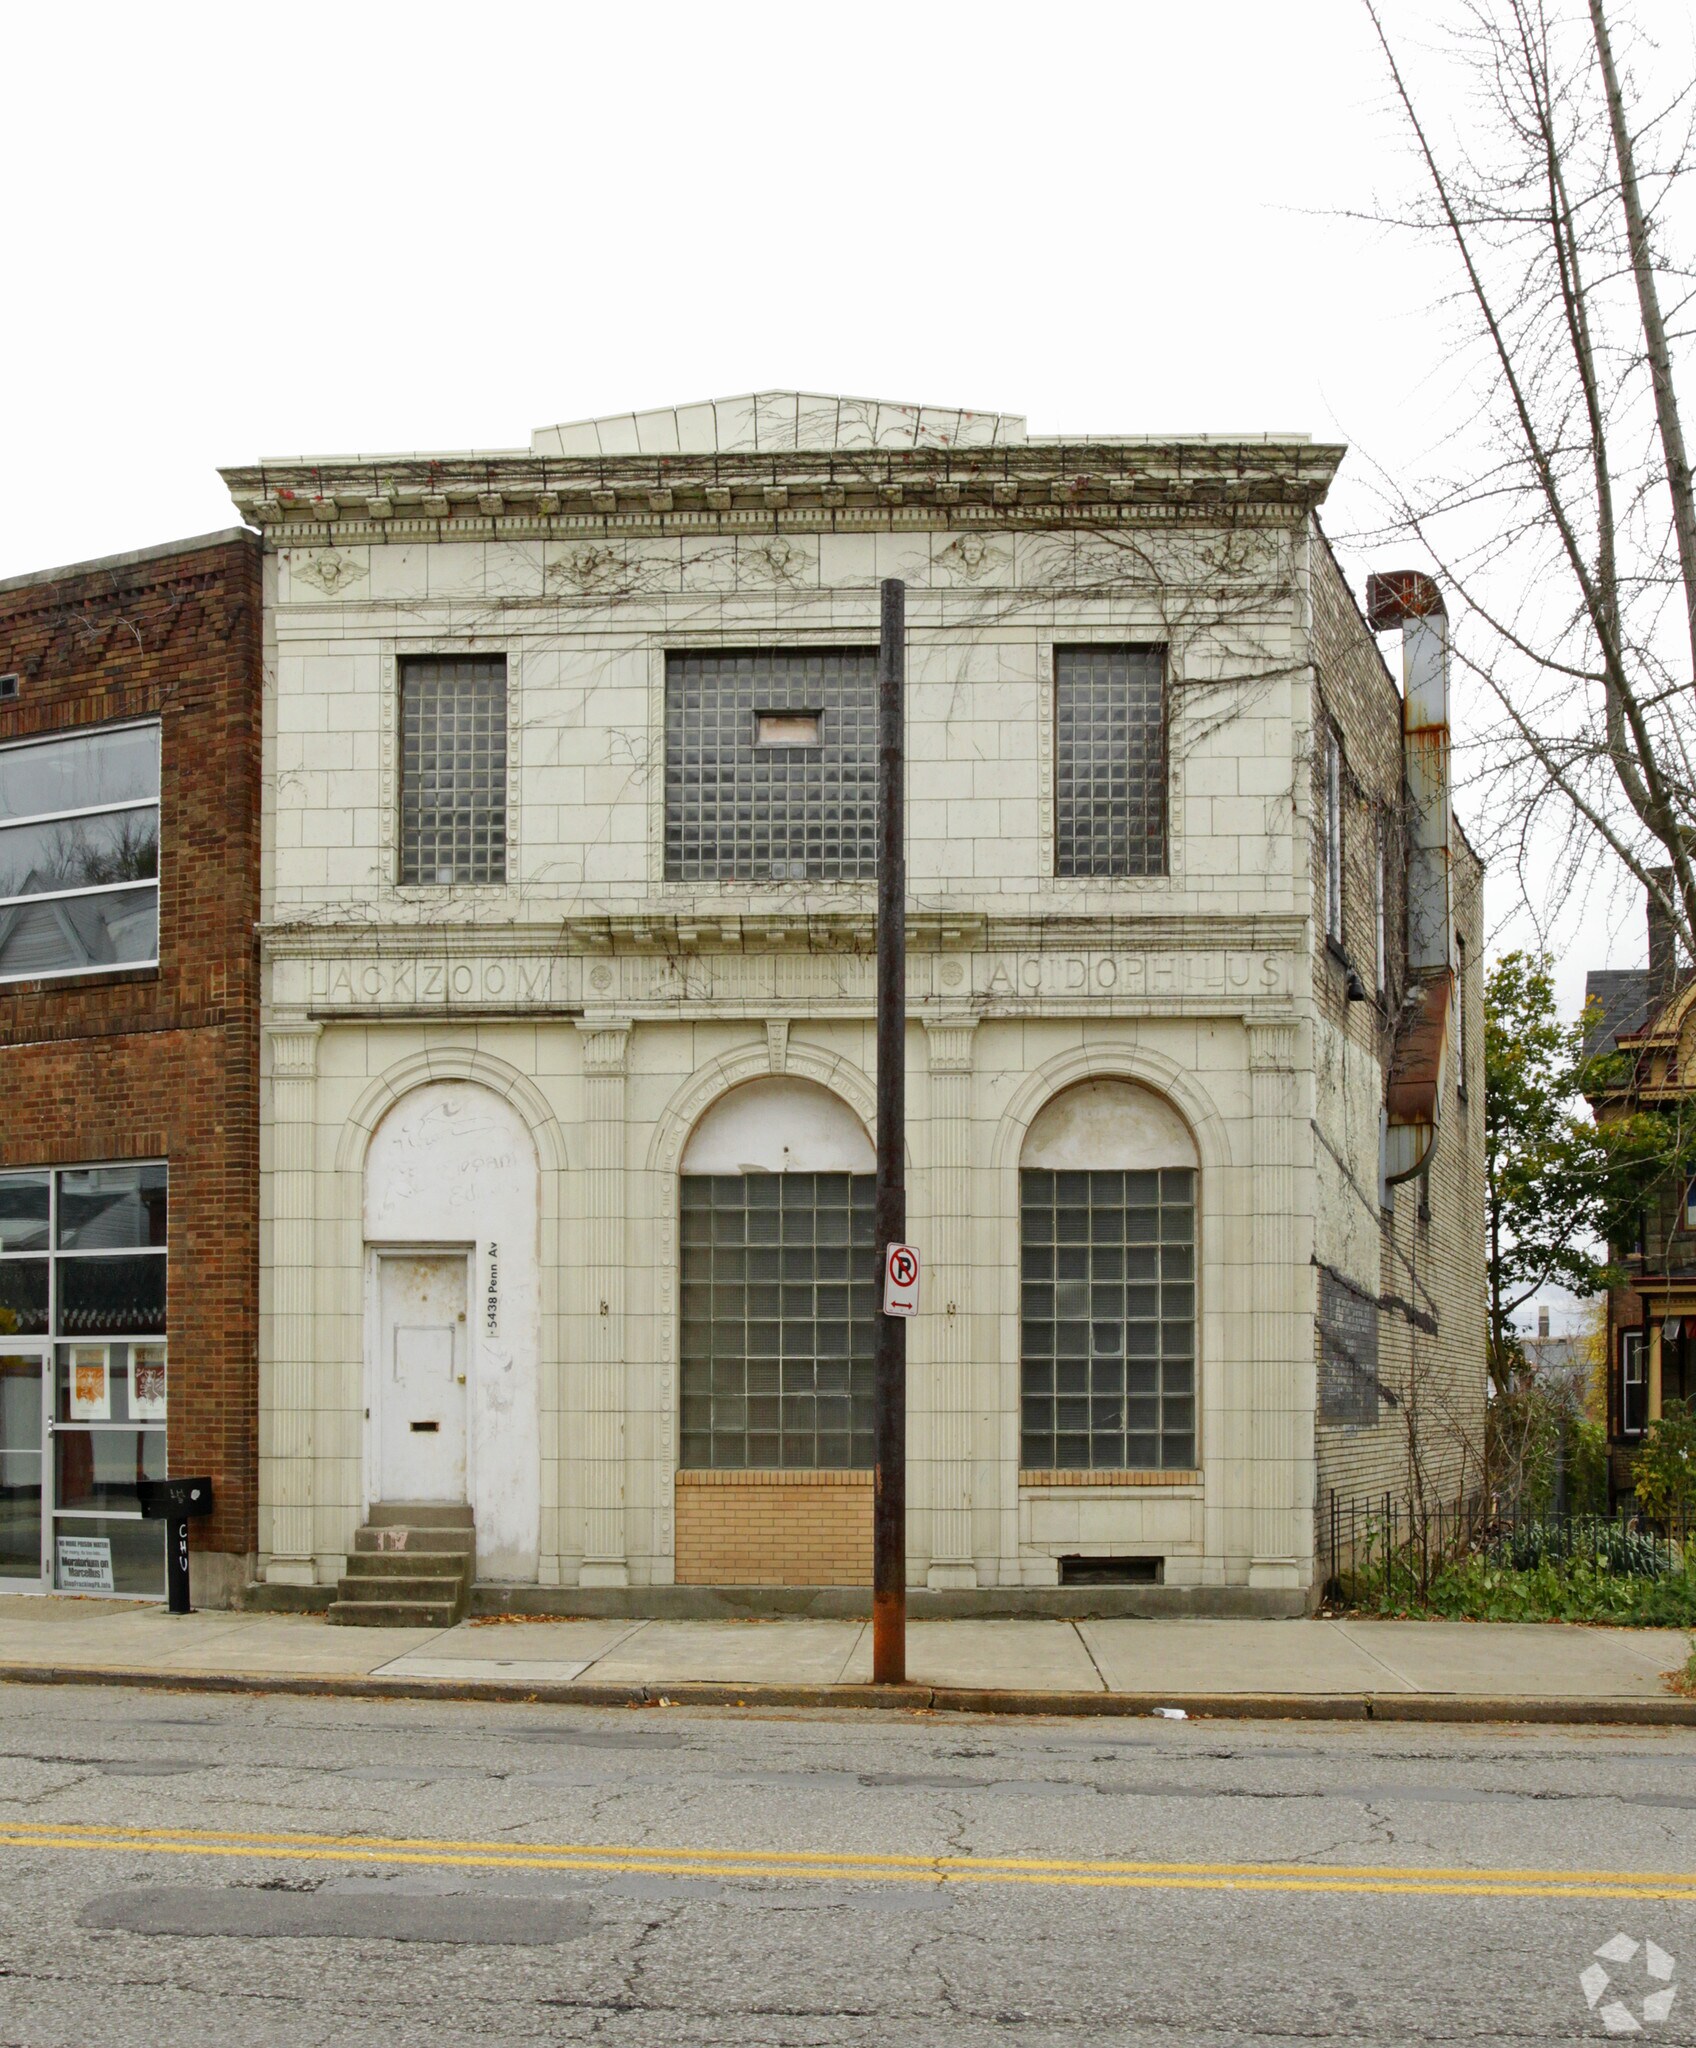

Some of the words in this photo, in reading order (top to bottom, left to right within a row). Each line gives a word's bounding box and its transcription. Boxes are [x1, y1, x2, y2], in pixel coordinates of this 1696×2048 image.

[308, 963, 546, 996] LACKZOOM
[988, 957, 1281, 990] ACIDOPHILUS
[488, 1241, 498, 1258] Av
[487, 1264, 498, 1293] Penn
[487, 1297, 498, 1328] 5438
[62, 1556, 99, 1567] Moratorium
[100, 1560, 109, 1568] on
